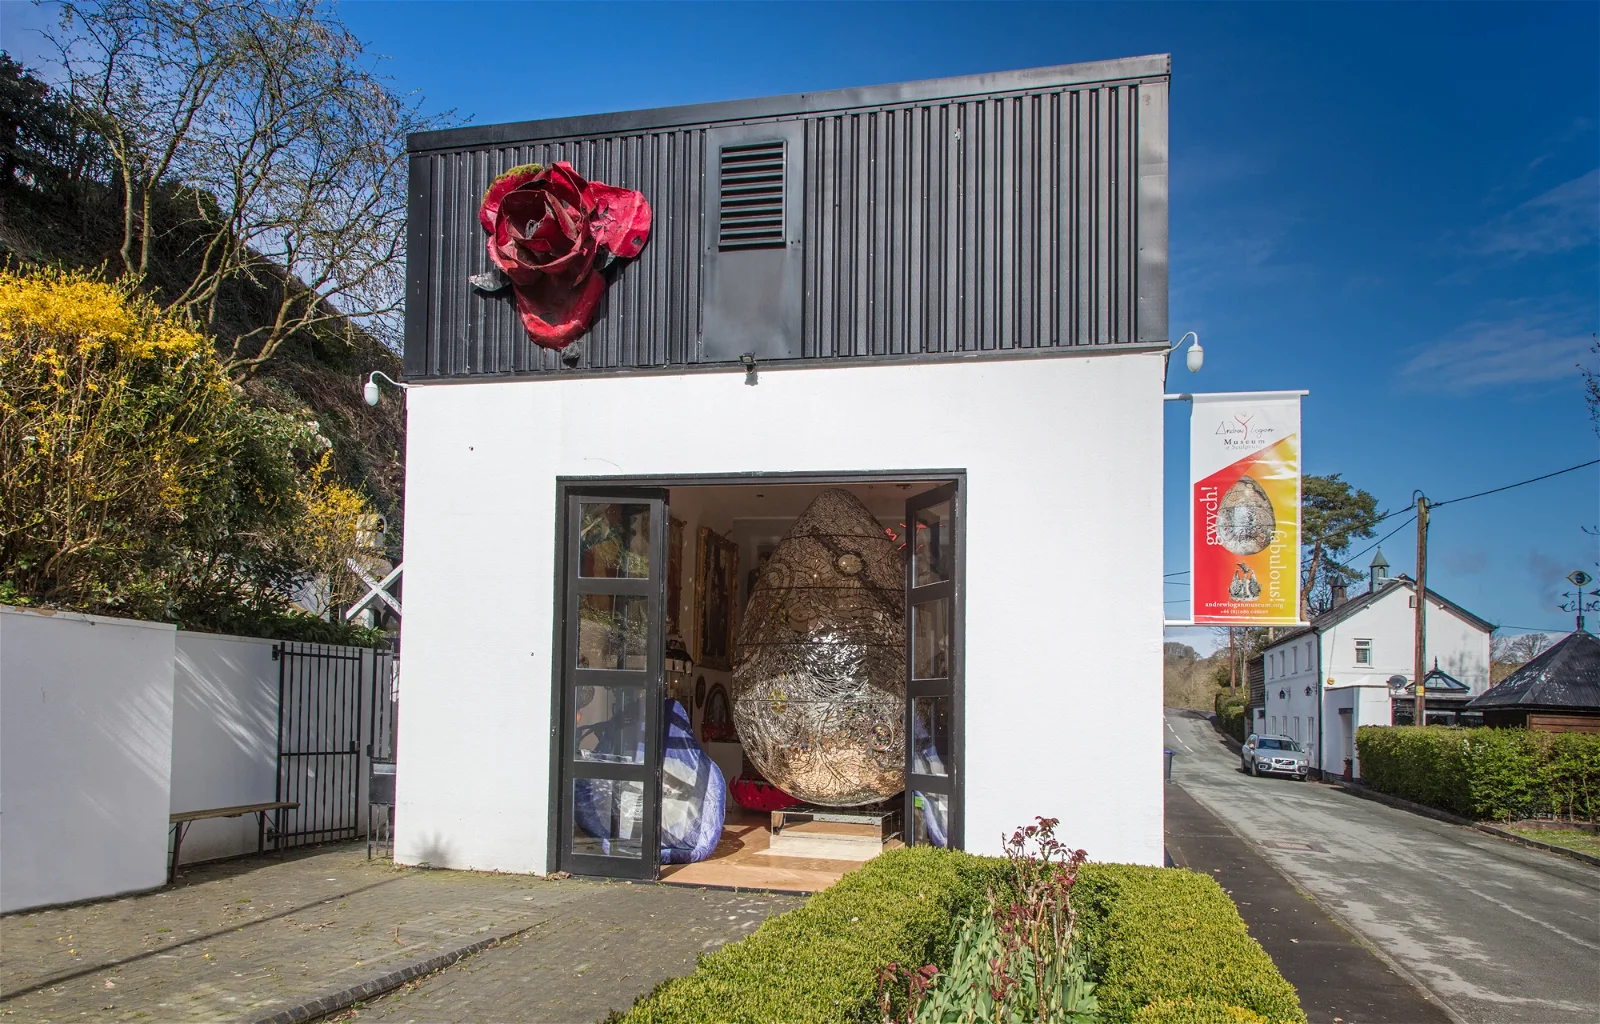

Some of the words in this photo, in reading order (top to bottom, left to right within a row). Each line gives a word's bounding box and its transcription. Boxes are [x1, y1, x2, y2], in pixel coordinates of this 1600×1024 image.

[1199, 486, 1224, 546] gwych!
[1269, 530, 1287, 602] fabulous!
[1205, 601, 1284, 609] andrewloganmuseum.org
